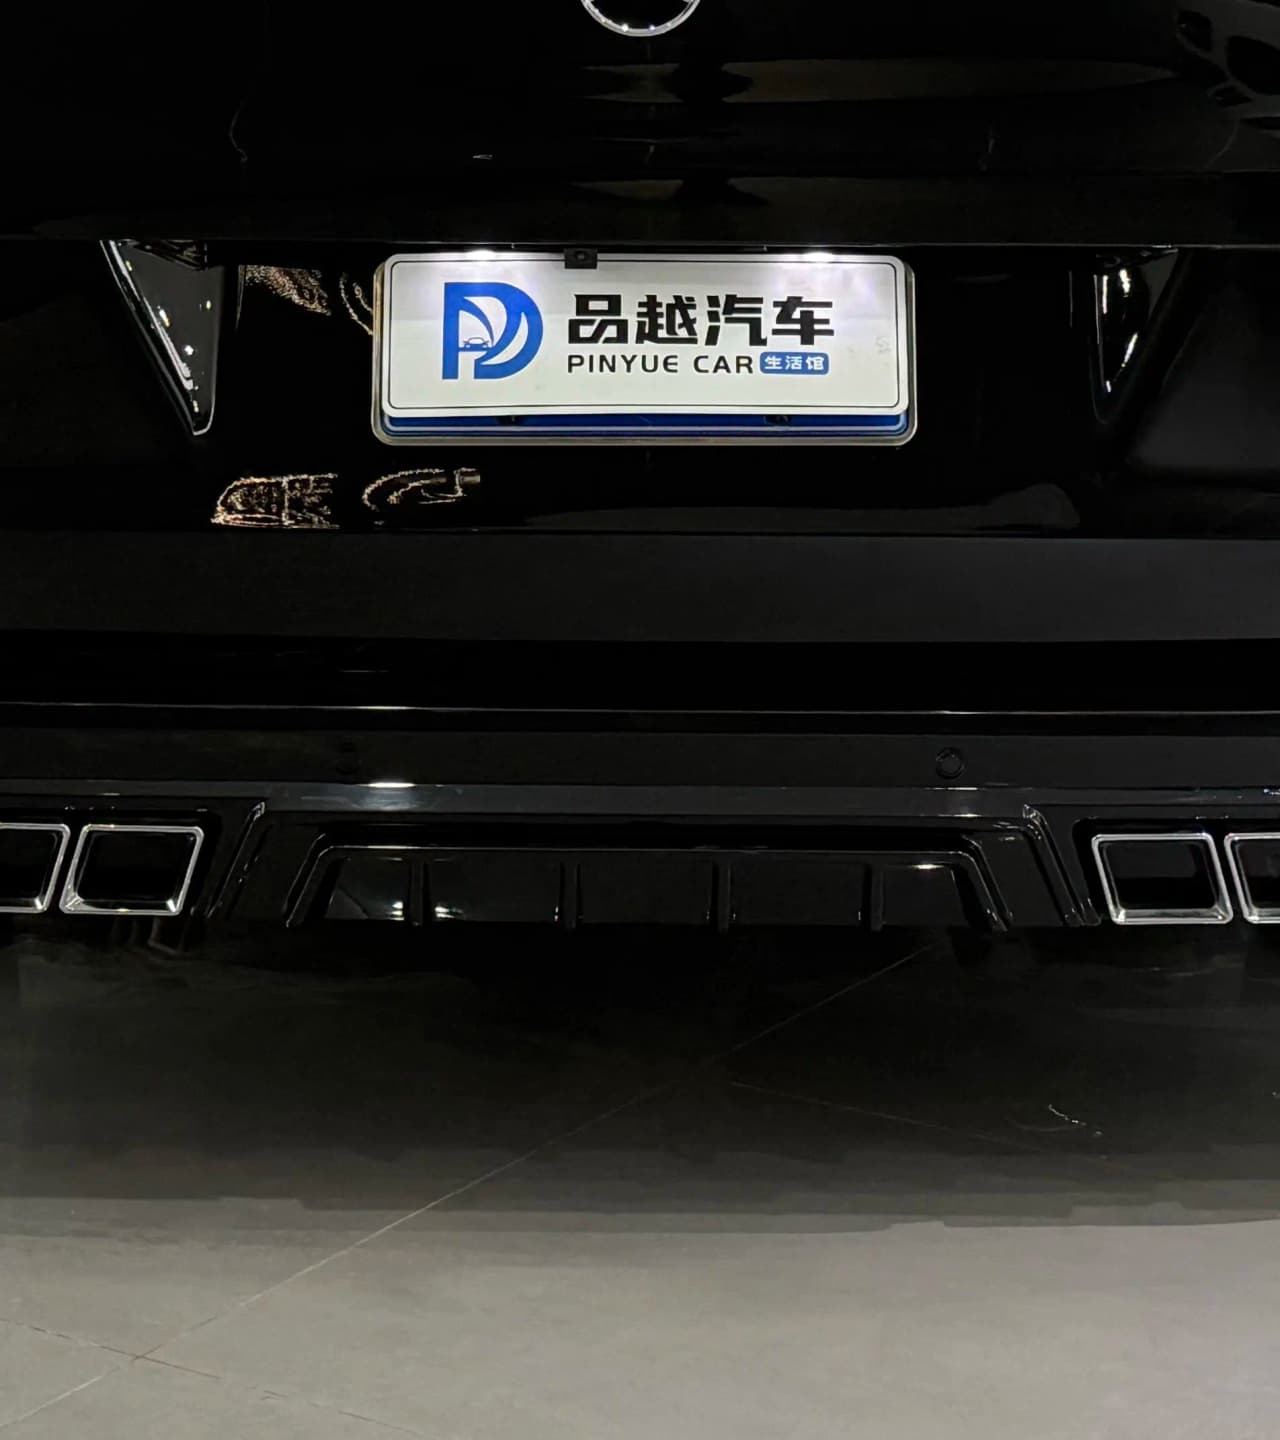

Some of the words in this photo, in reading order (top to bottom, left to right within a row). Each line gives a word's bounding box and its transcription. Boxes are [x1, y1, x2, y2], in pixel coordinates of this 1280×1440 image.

[568, 294, 835, 346] 品越汽车
[567, 355, 679, 374] PINYUE
[694, 356, 753, 374] CAR
[764, 356, 825, 371] 生活馆
